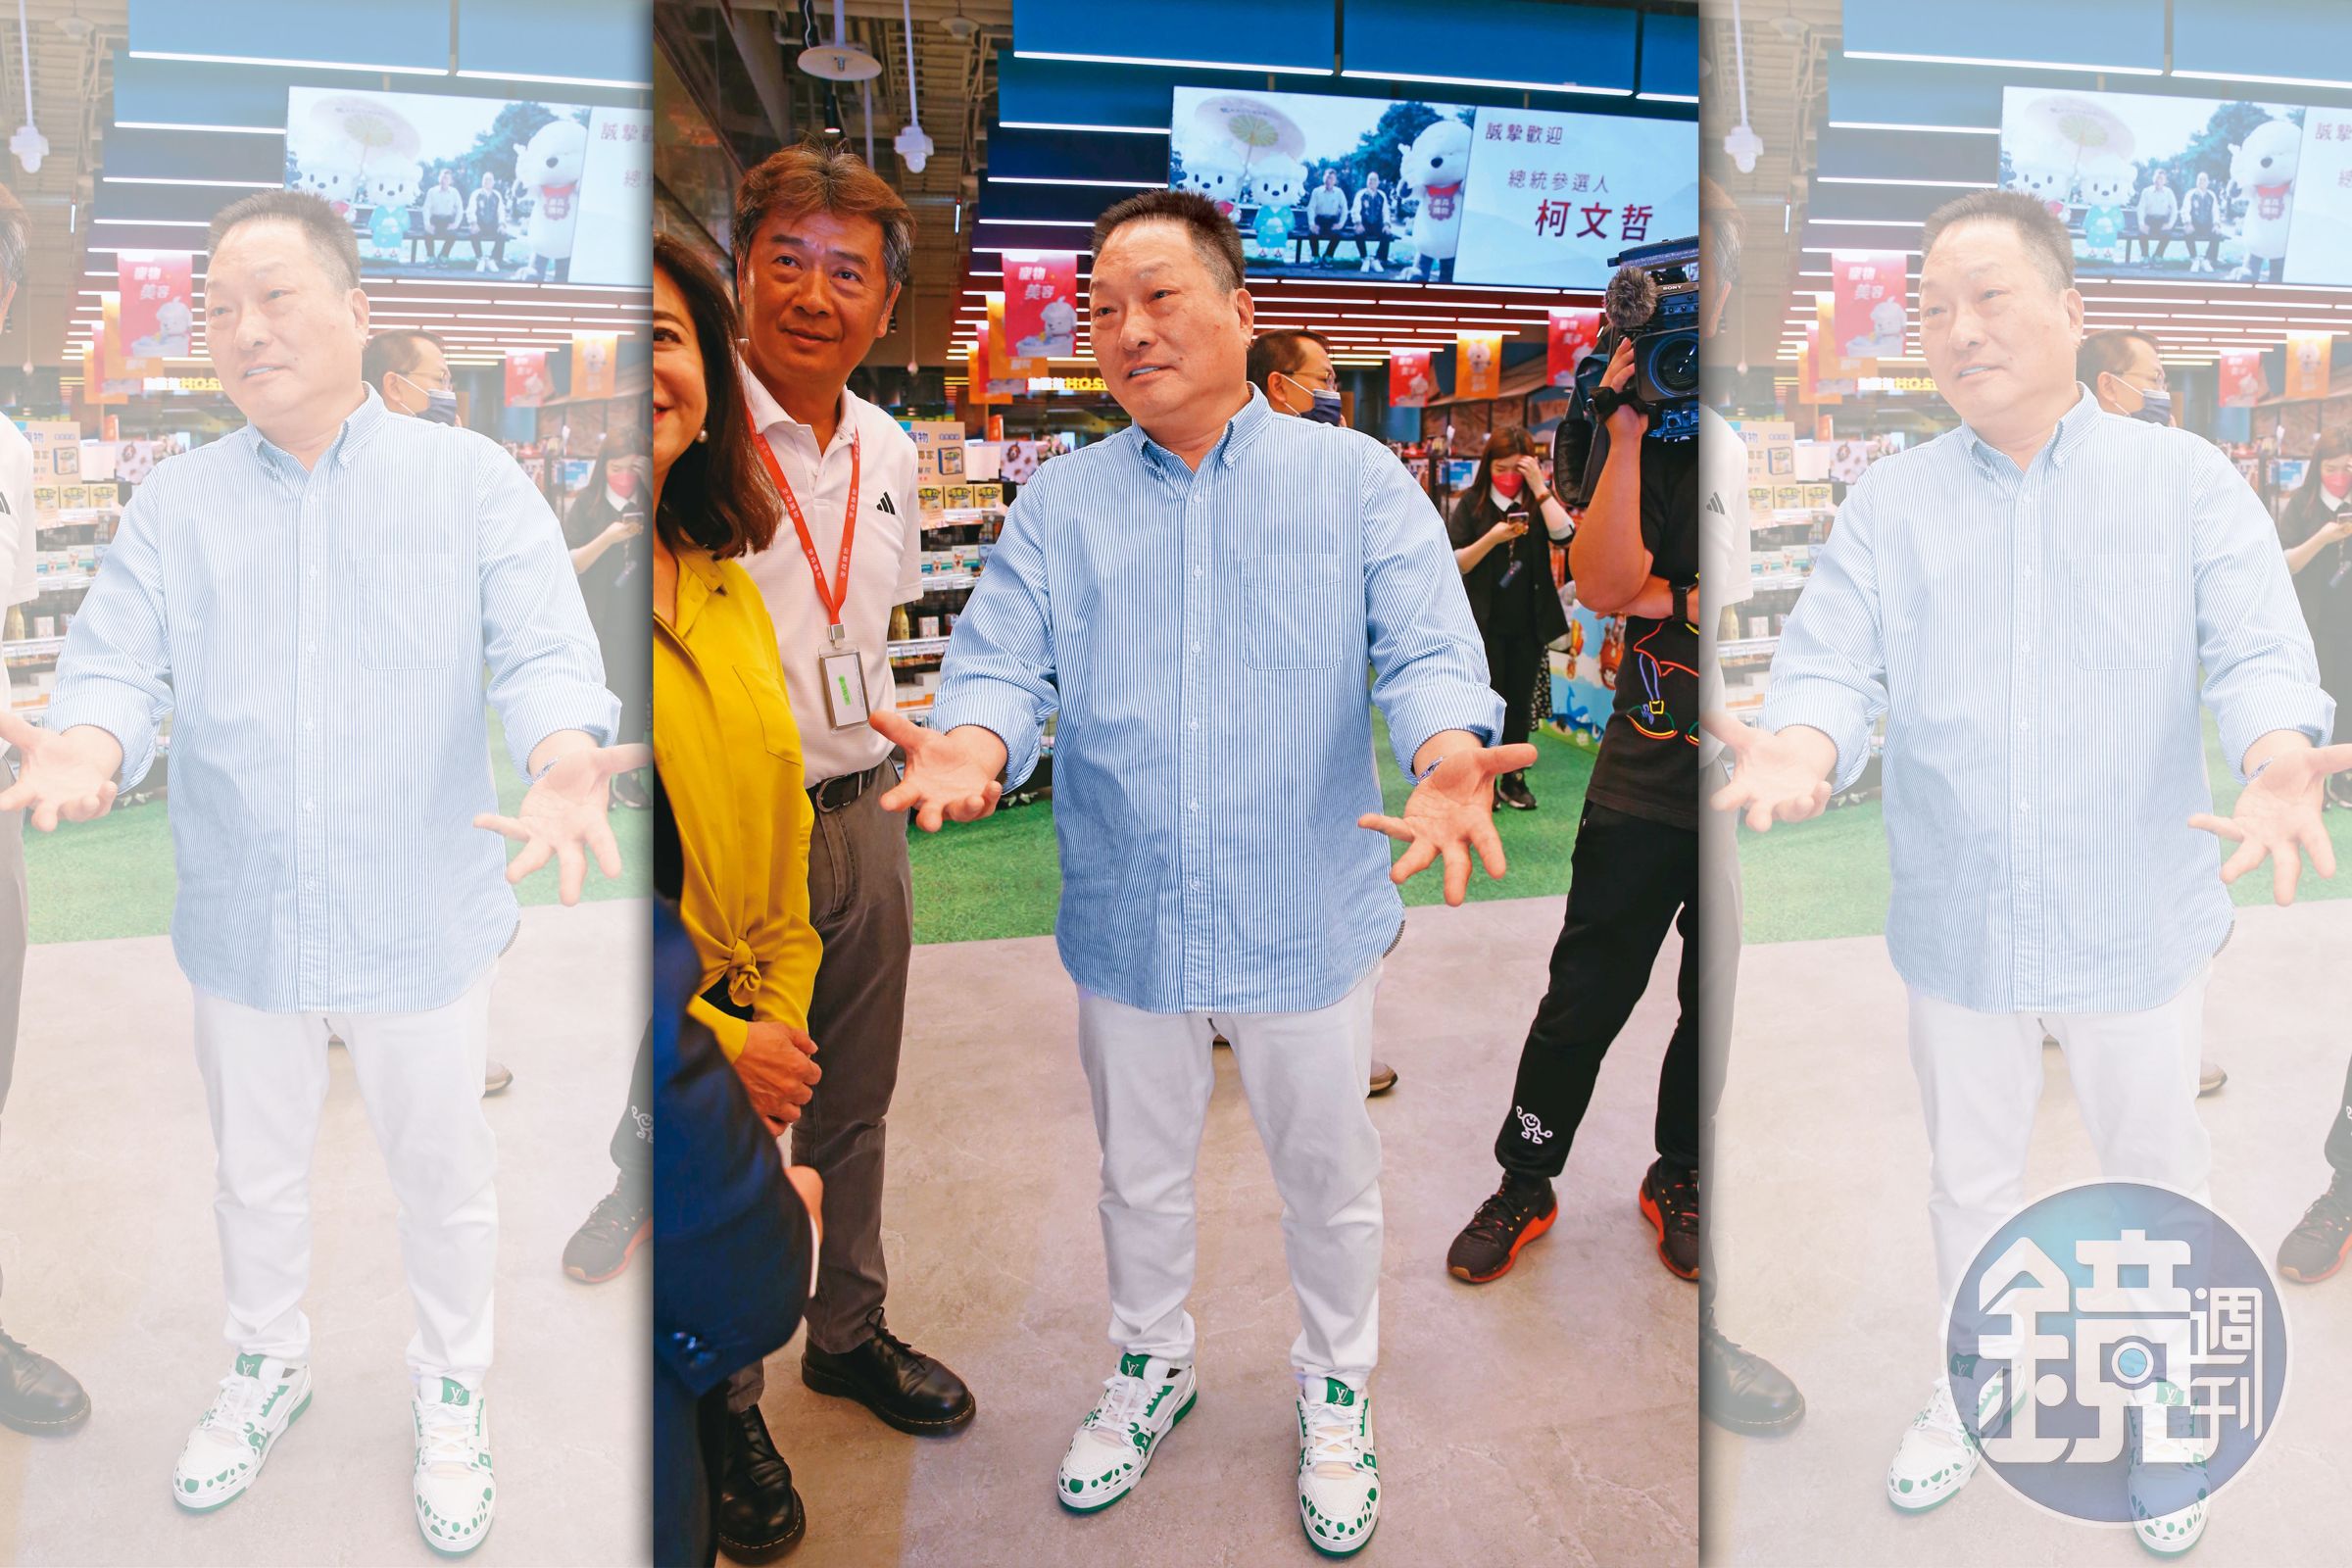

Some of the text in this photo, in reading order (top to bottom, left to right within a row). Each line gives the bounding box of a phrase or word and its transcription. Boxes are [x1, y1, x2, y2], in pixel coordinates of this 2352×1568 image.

[1486, 122, 1563, 145] 誠摯歡迎
[1508, 170, 1609, 193] 總統參選人
[1536, 199, 1653, 241] 柯文哲
